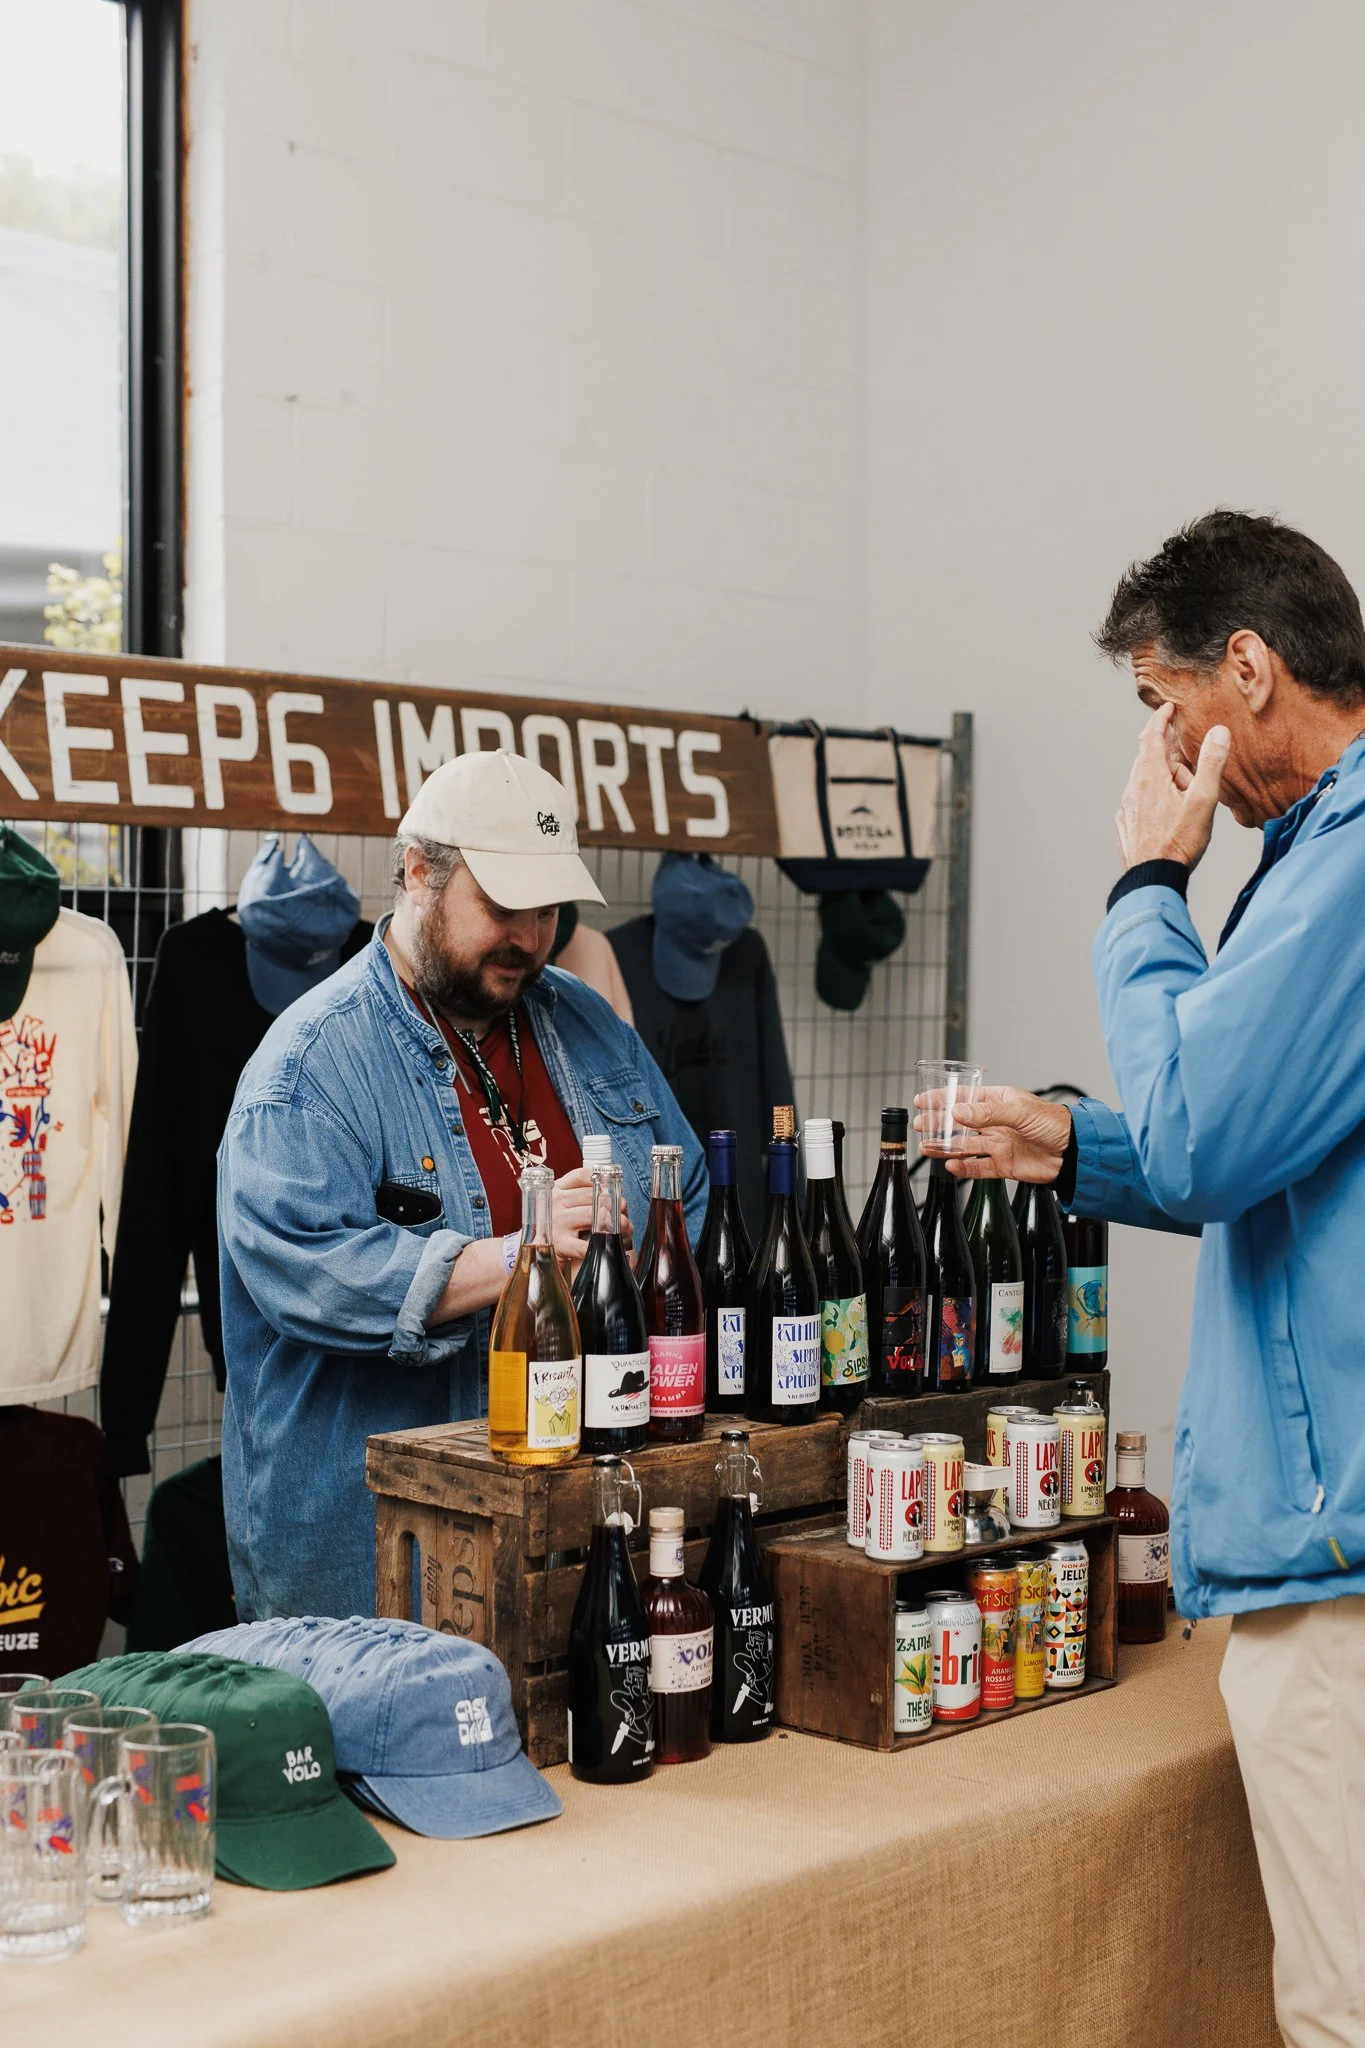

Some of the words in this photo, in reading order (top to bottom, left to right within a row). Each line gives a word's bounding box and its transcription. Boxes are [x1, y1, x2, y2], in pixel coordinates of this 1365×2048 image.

[0, 668, 333, 815] KEEP6
[373, 699, 730, 838] IMPORTS
[650, 1363, 698, 1376] AUEN
[650, 1389, 687, 1402] GAMBA
[944, 1460, 964, 1491] LAP
[1060, 1568, 1086, 1581] JELLY
[941, 1631, 981, 1686] bri
[985, 1675, 1006, 1683] ROSSA
[907, 1697, 922, 1718] THÉ
[284, 1745, 313, 1769] BAR
[281, 1760, 322, 1785] VOLO
